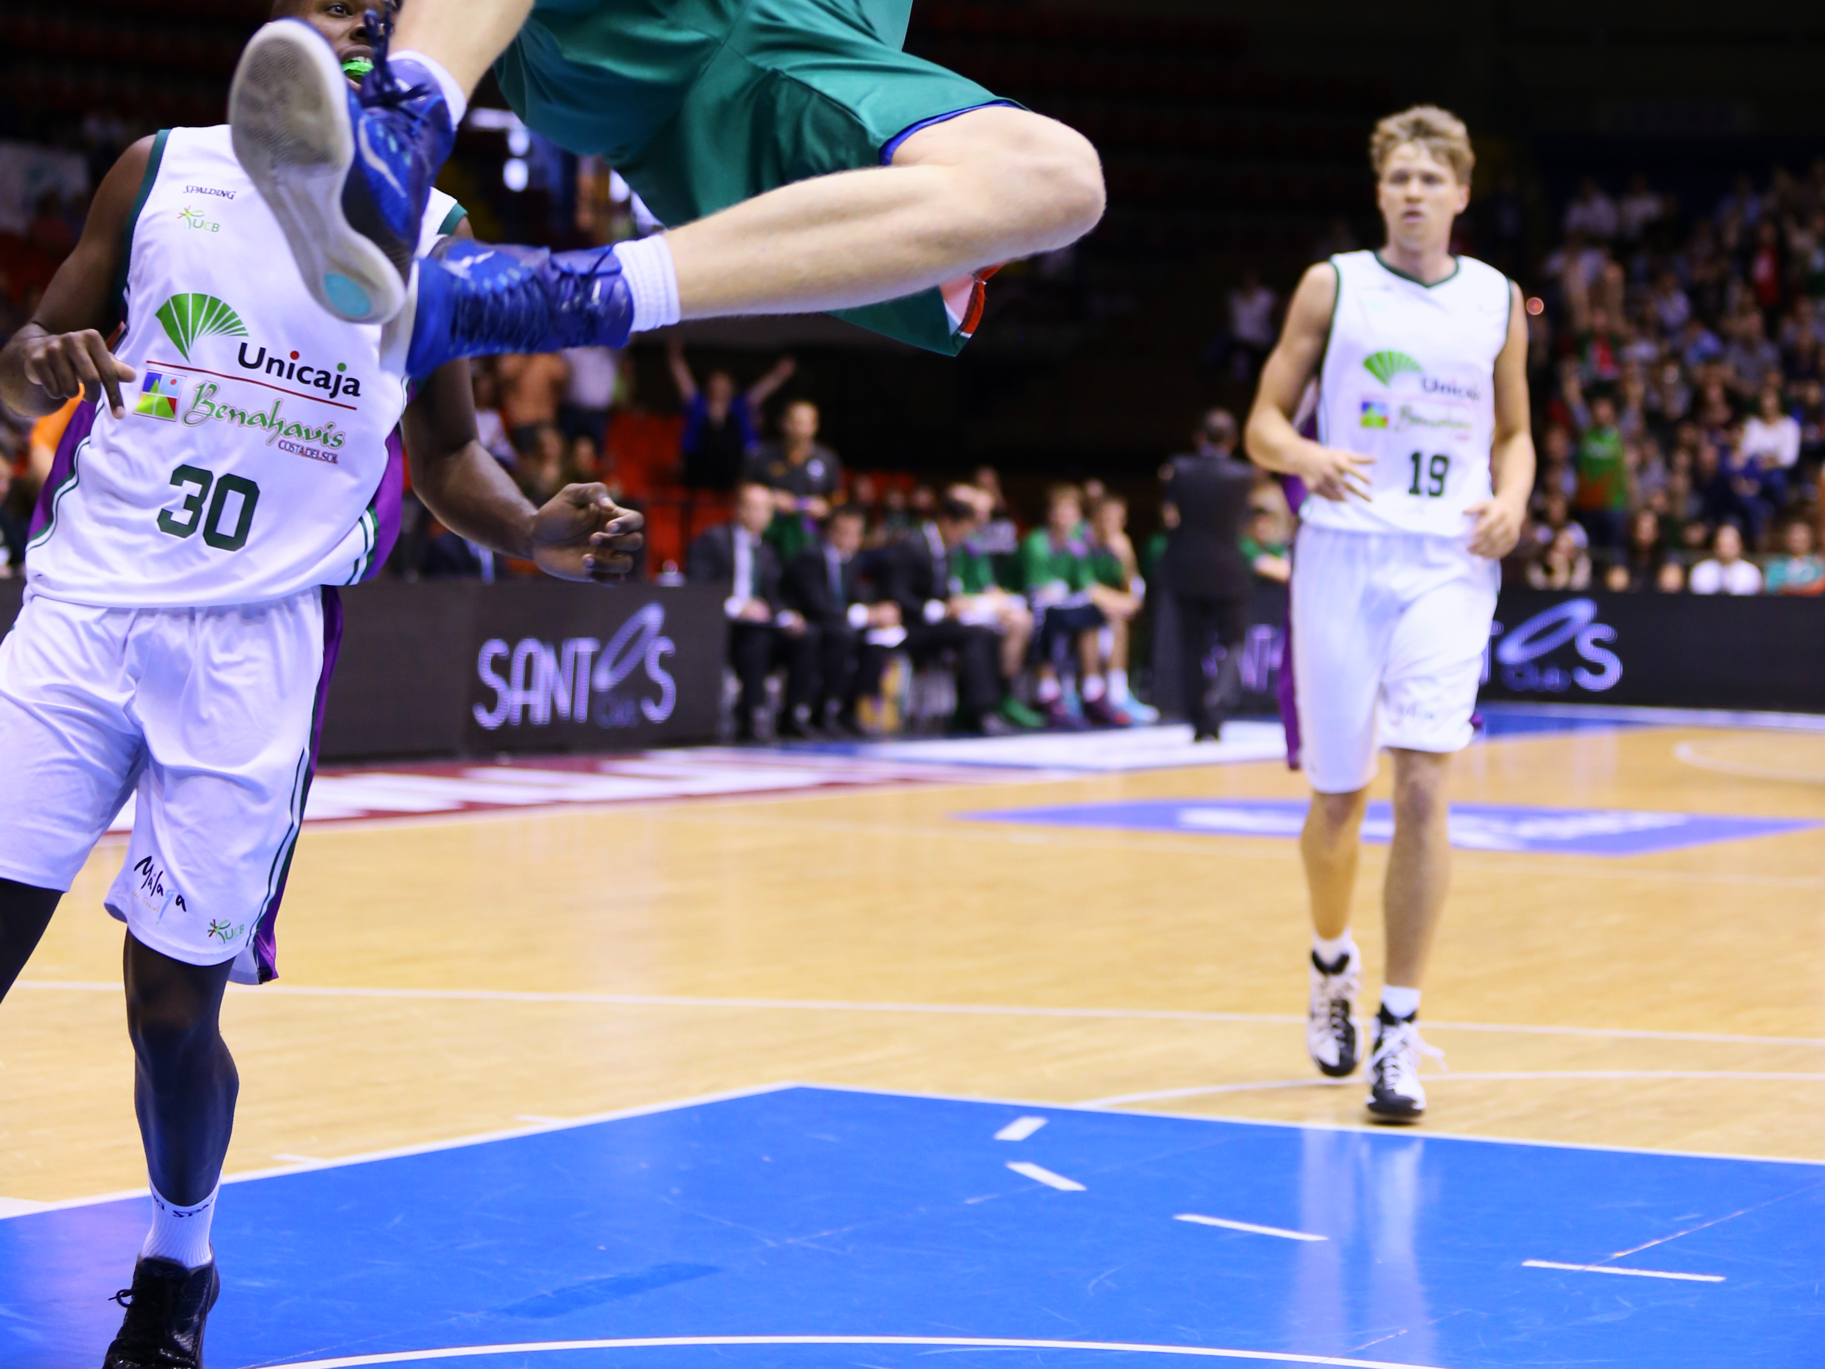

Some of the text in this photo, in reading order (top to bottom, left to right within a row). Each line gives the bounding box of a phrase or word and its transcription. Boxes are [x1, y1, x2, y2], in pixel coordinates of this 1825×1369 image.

[182, 185, 237, 200] SPALDING
[237, 342, 361, 399] Unicaja
[278, 440, 339, 465] COSTA DEL SOL
[1408, 451, 1450, 497] 19
[156, 463, 261, 553] 30
[472, 602, 677, 730] SANTOS
